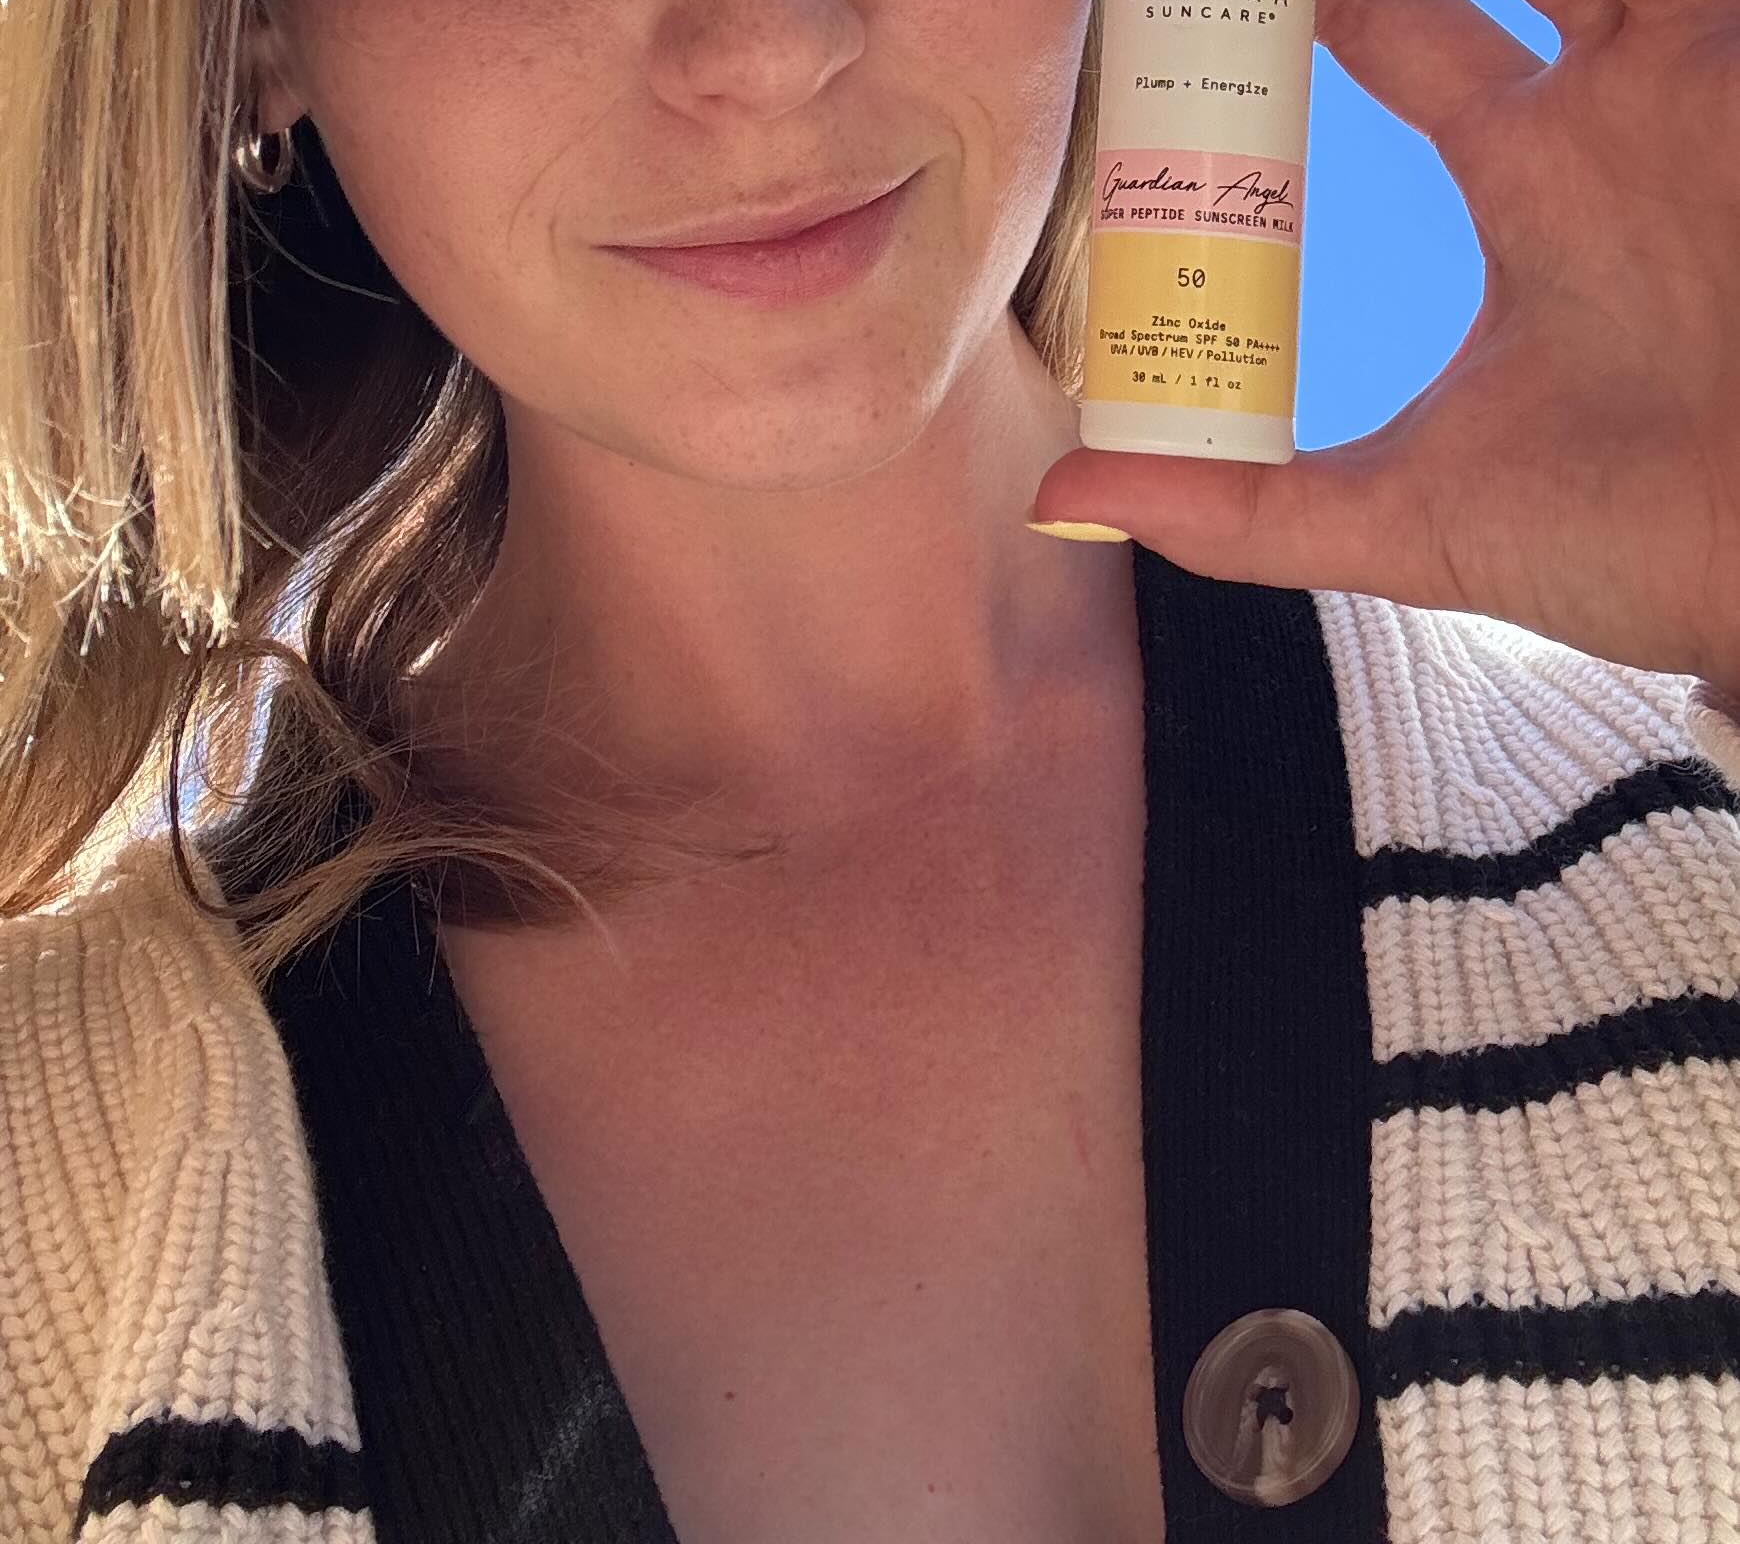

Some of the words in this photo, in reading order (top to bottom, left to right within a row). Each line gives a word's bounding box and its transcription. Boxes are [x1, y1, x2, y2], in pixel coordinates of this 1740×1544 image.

[1136, 77, 1174, 90] Plump
[1184, 80, 1192, 88] +
[1201, 78, 1269, 96] Energize
[1103, 162, 1207, 211] Guardian
[1213, 171, 1294, 214] Angel
[1131, 208, 1185, 220] PEPTIDE
[1195, 210, 1266, 227] SUNSCREEN
[1273, 219, 1293, 232] MILK
[1177, 268, 1206, 288] 50
[1152, 316, 1181, 327] Zinc
[1189, 318, 1226, 331] Oxide
[1100, 329, 1125, 339] Broad
[1131, 330, 1188, 343] Spectrum
[1196, 334, 1217, 345] SPF
[1226, 336, 1239, 347] 50
[1247, 338, 1280, 352] PA++++
[1132, 371, 1145, 382] 30
[1152, 372, 1166, 384] mL
[1175, 374, 1181, 384] /
[1190, 376, 1196, 386] 1
[1206, 377, 1220, 388] fl
[1228, 381, 1241, 390] oz
